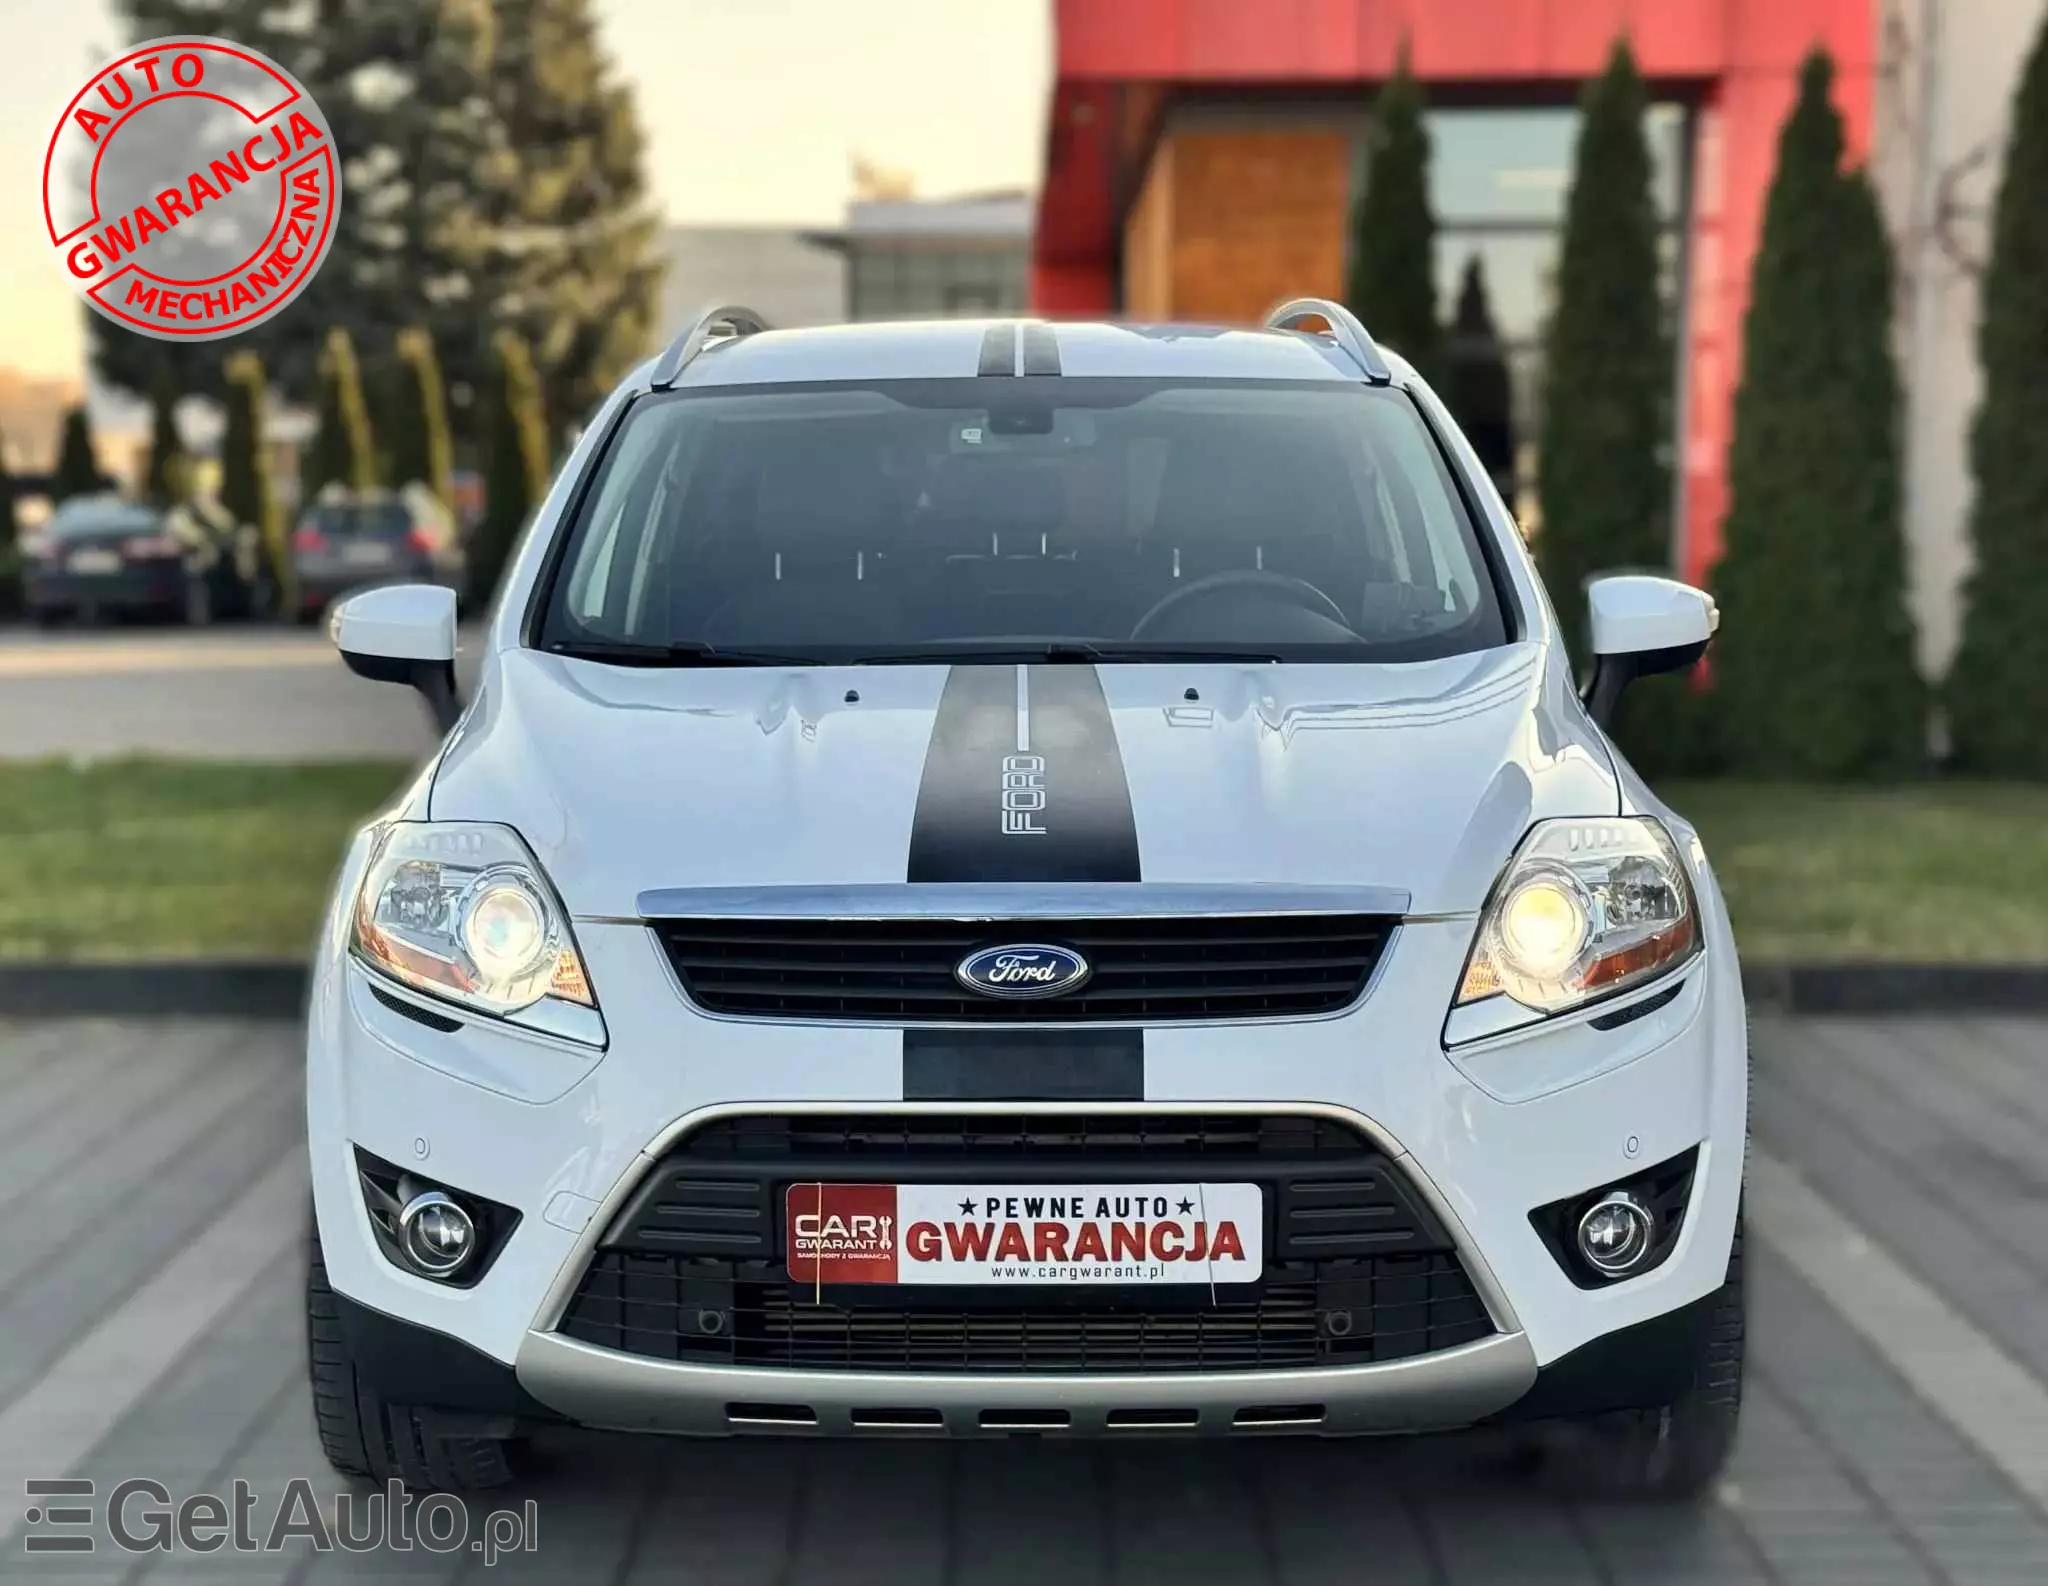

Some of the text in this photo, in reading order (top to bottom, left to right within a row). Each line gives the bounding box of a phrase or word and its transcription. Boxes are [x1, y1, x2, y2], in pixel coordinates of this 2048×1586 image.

[1002, 755, 1047, 835] FORD
[988, 954, 1057, 983] Ford
[986, 1196, 1168, 1219] PEWNE AUTO
[795, 1214, 878, 1238] CAR
[795, 1239, 878, 1250] GWARANT
[905, 1220, 1246, 1263] GWARANCJA
[991, 1263, 1165, 1281] www.cargwarant.pl
